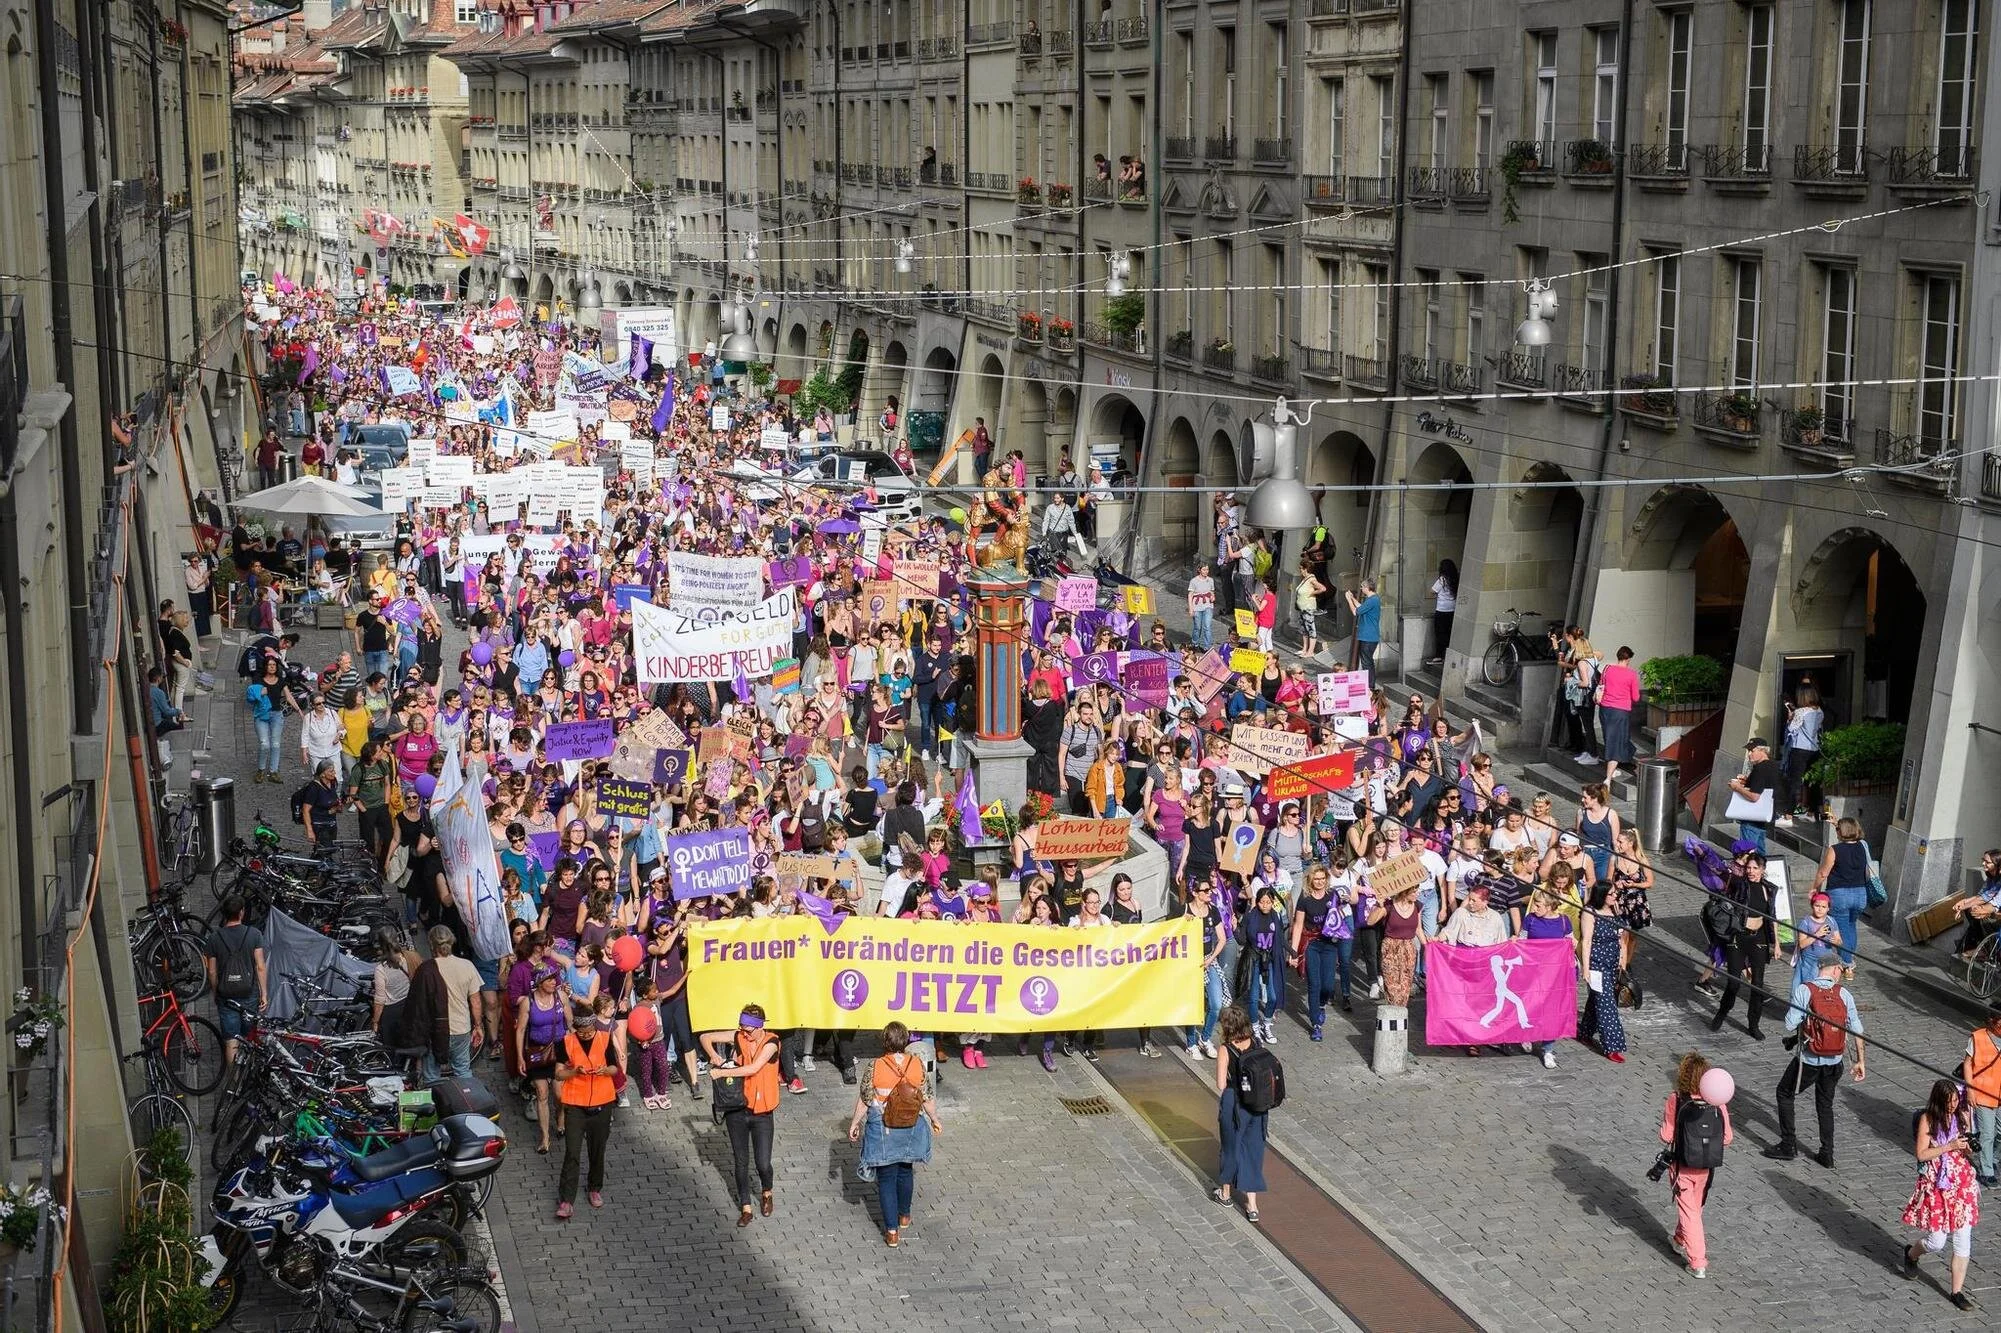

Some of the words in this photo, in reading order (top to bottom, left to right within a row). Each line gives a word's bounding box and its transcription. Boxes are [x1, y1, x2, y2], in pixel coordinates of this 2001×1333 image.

[572, 747, 592, 757] NOW
[603, 783, 648, 800] Schluss
[599, 800, 615, 810] mit
[617, 802, 648, 816] gratis
[1040, 822, 1092, 836] Lohn
[1098, 820, 1130, 836] für
[691, 841, 720, 863] DON'T
[720, 839, 747, 858] TELL
[1035, 839, 1128, 855] Hausarbeit
[692, 870, 709, 890] ME
[735, 863, 749, 884] DO
[820, 936, 954, 963] verändern
[964, 941, 1003, 965] die
[1013, 934, 1188, 968] Gesellschaft!
[887, 972, 1002, 1014] JETZT
[249, 1202, 295, 1218] Africa
